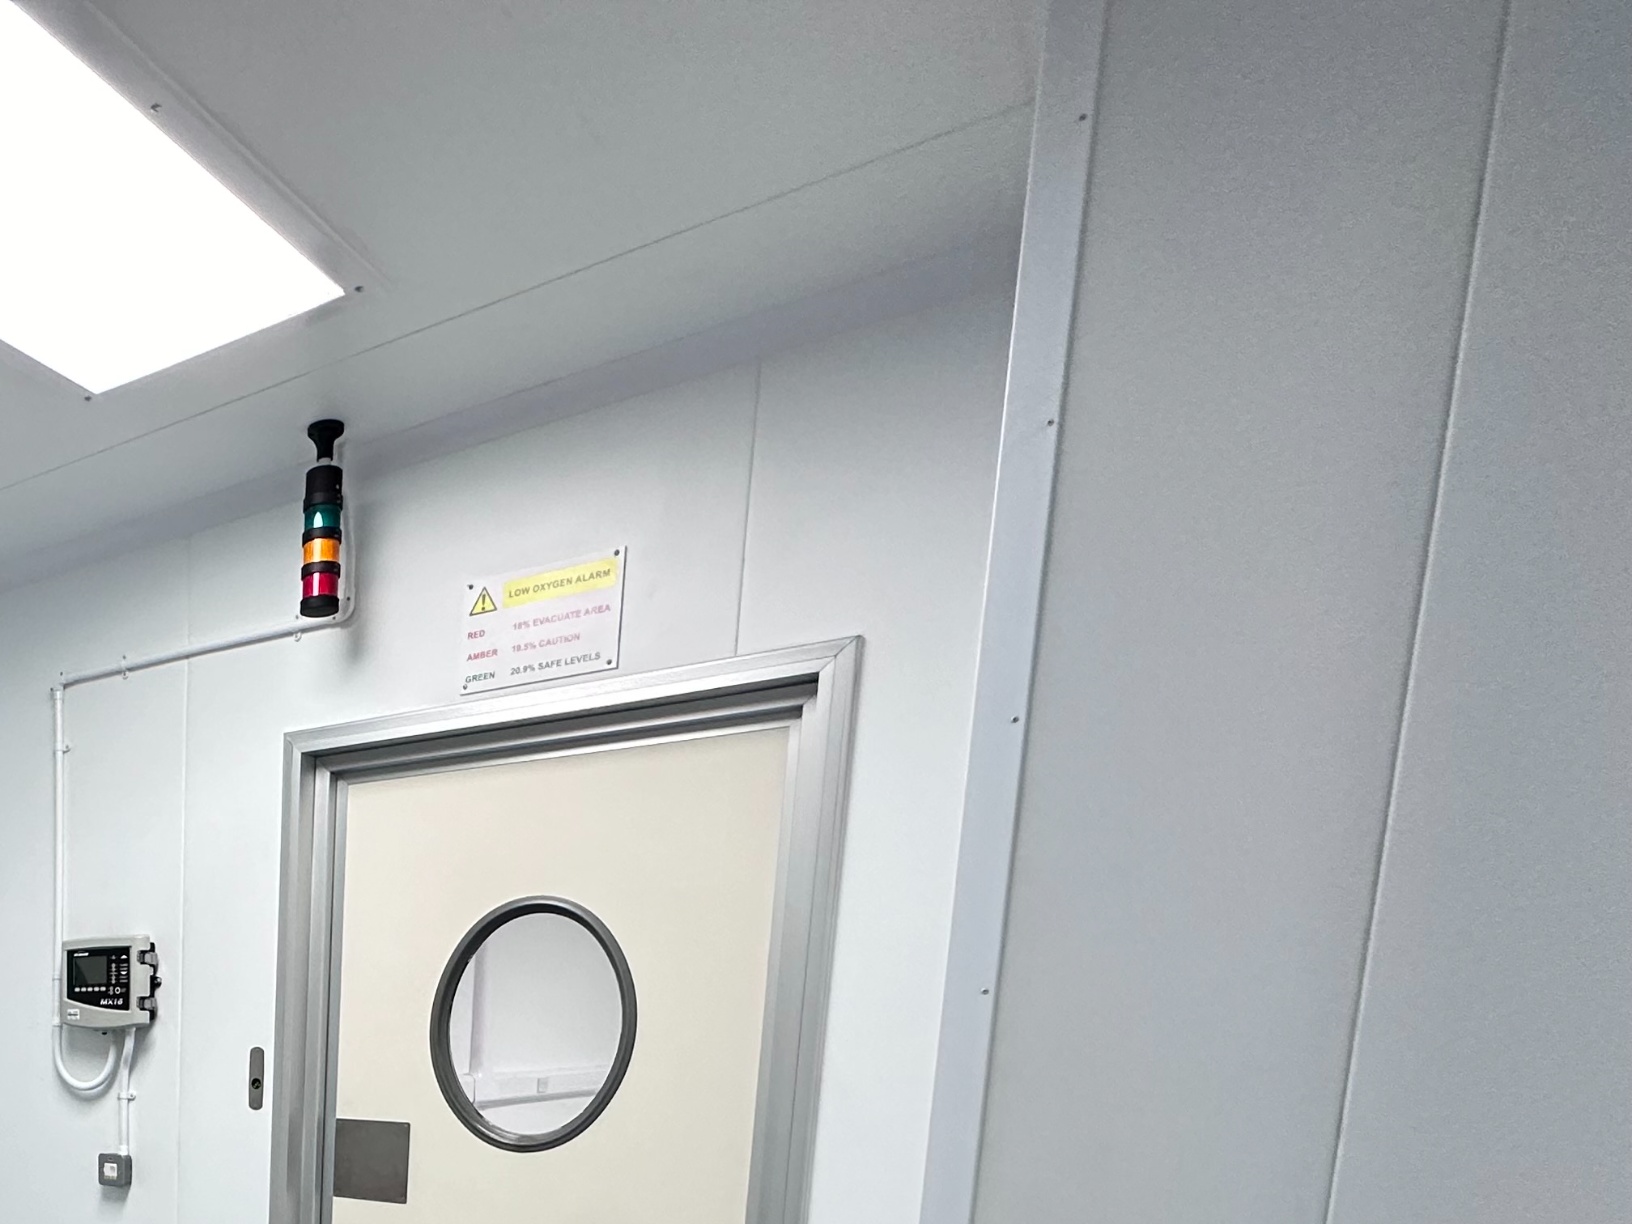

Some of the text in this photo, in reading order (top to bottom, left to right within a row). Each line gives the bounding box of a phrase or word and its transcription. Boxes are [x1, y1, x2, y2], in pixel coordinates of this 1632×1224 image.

[508, 569, 611, 598] LOW OXYGEN ALARM
[467, 630, 485, 640] RED
[533, 610, 581, 627] EVACUATE
[584, 604, 611, 616] AREA
[466, 649, 498, 662] AMBER
[538, 633, 581, 648] CAUTION
[465, 652, 601, 683] GREEN 20.9% SAFE LEVELS
